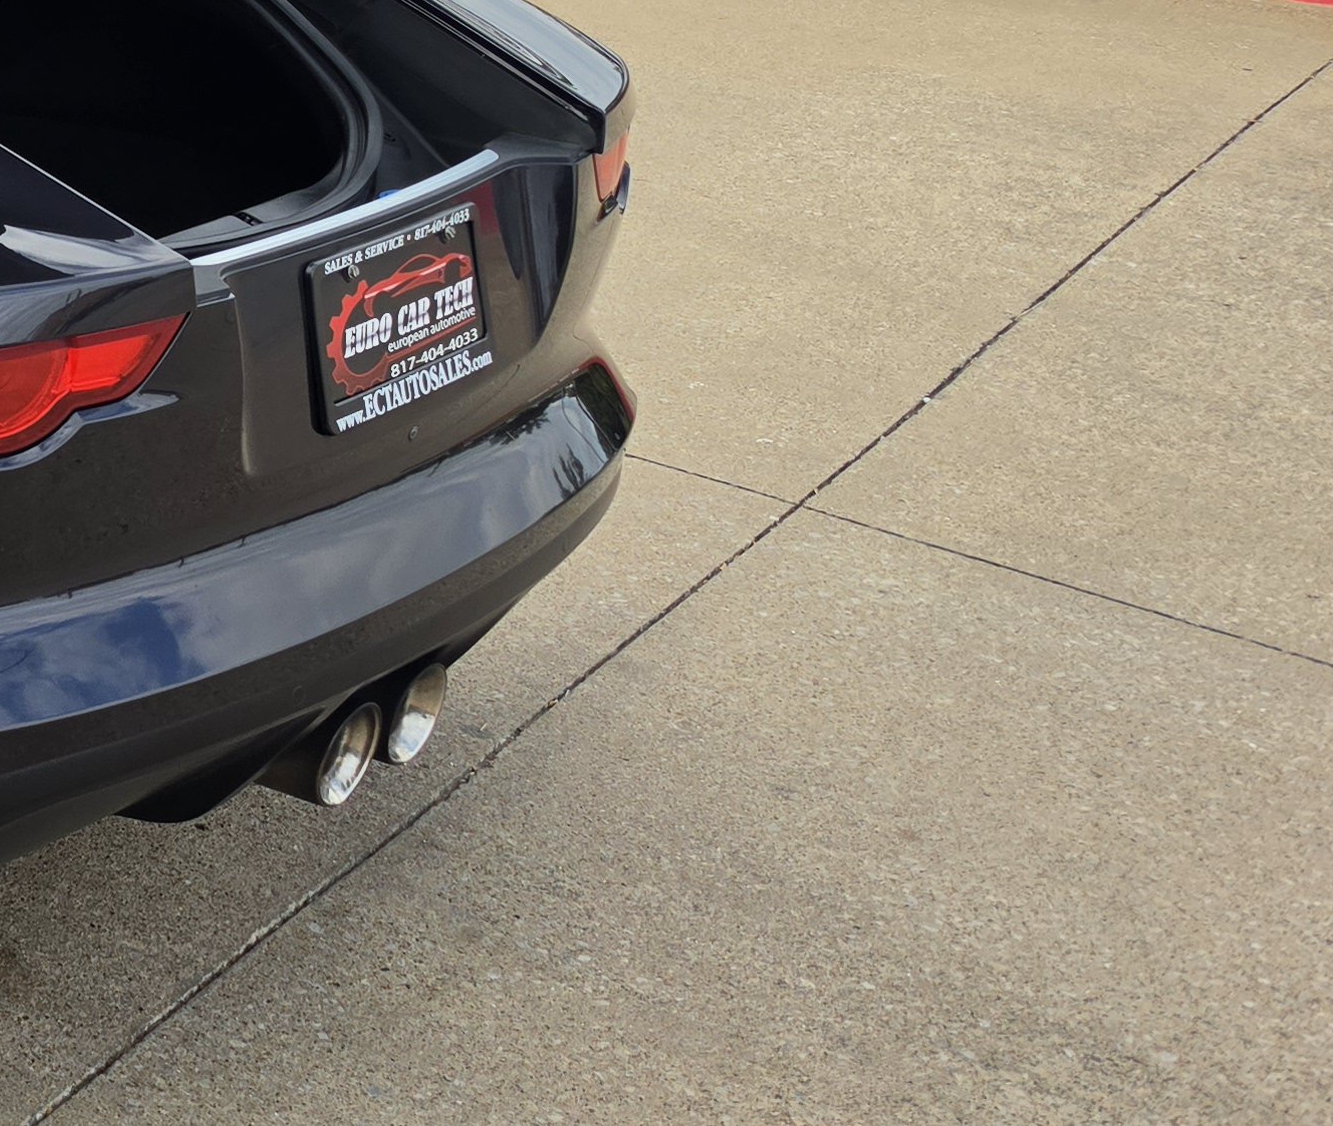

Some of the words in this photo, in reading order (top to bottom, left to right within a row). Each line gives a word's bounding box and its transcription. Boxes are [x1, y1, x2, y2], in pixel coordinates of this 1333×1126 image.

[324, 258, 353, 275] SALES
[354, 250, 363, 263] &
[365, 235, 405, 260] SERVICE
[414, 208, 470, 241] 817-404-4033
[343, 312, 393, 359] EURO
[397, 296, 431, 333] CAR
[434, 276, 474, 320] TECH
[387, 324, 430, 353] european
[430, 306, 476, 335] automotive
[390, 328, 479, 378] 817-404-4033
[336, 349, 493, 432] www.ECTAUTOSALES.com
